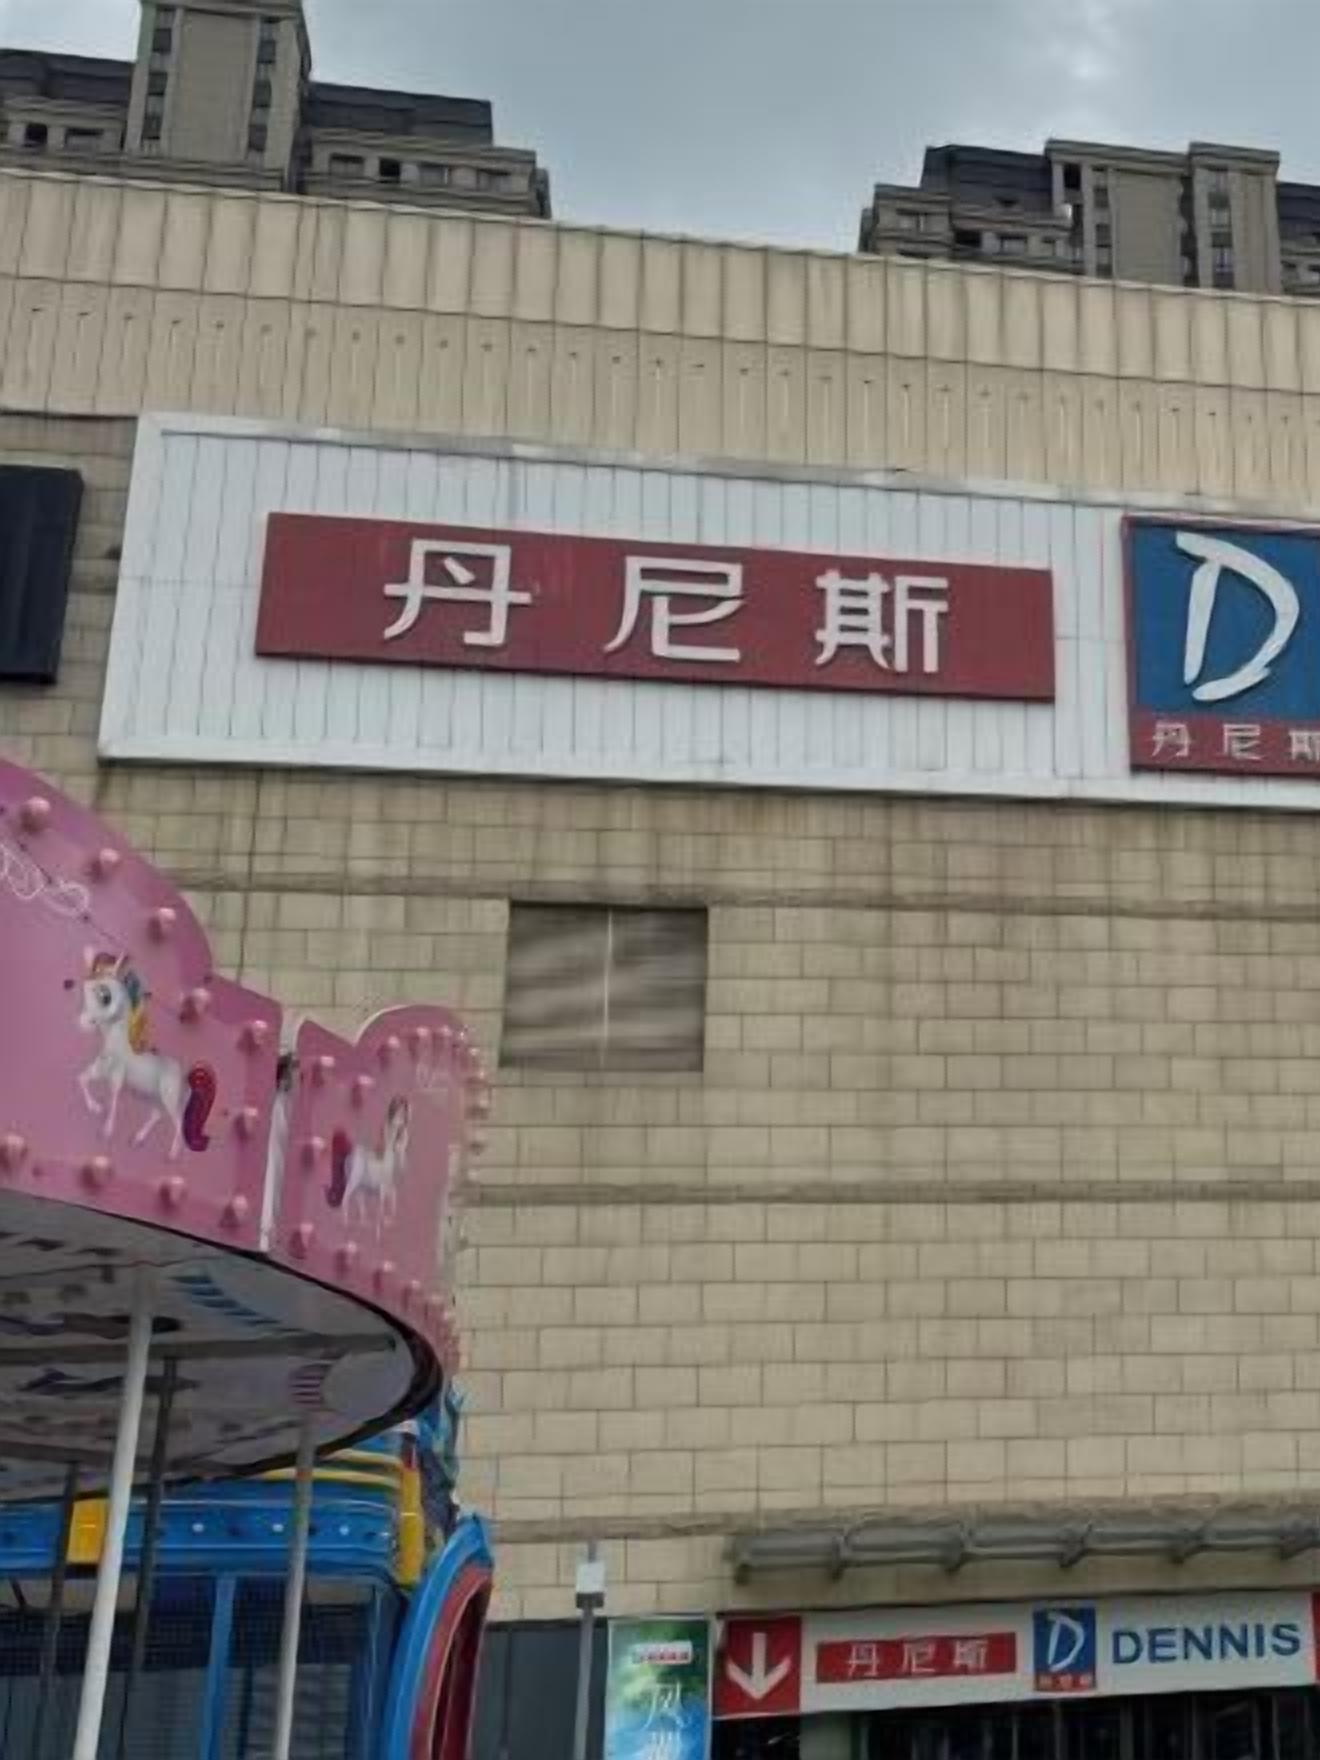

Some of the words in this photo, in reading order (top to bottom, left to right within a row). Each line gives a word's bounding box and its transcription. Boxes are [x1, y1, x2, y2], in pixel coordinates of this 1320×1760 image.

[383, 538, 949, 674] 丹尼斯
[848, 1639, 989, 1677] 丹尼斯
[1112, 1622, 1301, 1665] DENNIS
